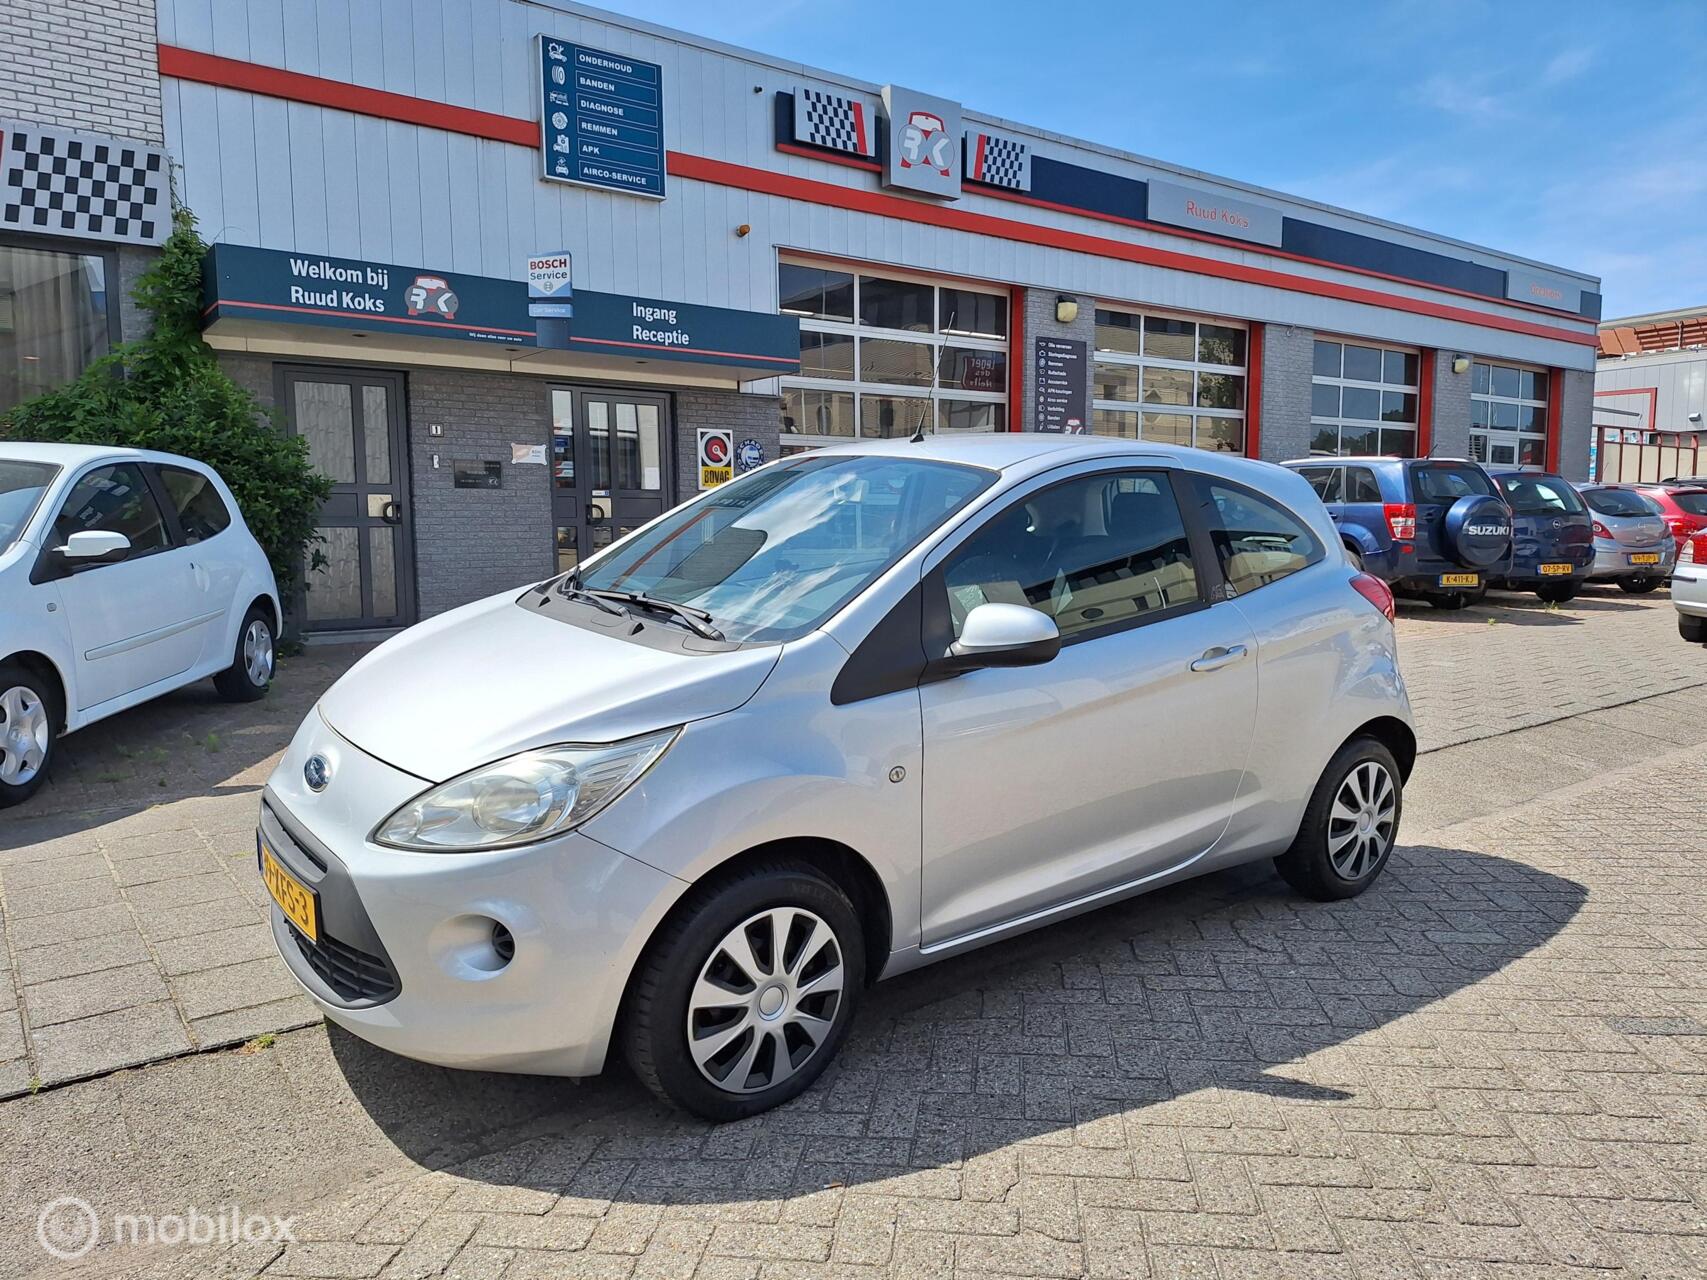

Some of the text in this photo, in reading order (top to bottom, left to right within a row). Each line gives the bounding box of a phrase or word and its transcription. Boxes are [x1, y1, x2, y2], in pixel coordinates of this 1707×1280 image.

[579, 54, 632, 73] ONDERHOUD
[580, 77, 615, 91] BANDEN
[581, 101, 624, 116] DIAGNOSE
[581, 122, 618, 136] REMMEN
[582, 145, 600, 154] APK
[583, 167, 647, 185] AIRCO-SERVICE
[1186, 200, 1249, 228] Ruud Koks
[530, 258, 567, 270] BOSCH
[290, 258, 389, 290] Welkom bij
[530, 270, 567, 280] Service
[290, 286, 385, 312] Ruud Koks
[632, 302, 677, 325] Ingang
[633, 325, 690, 346] Receptie
[704, 470, 730, 484] BOVAG
[1468, 526, 1510, 536] SUZUKI
